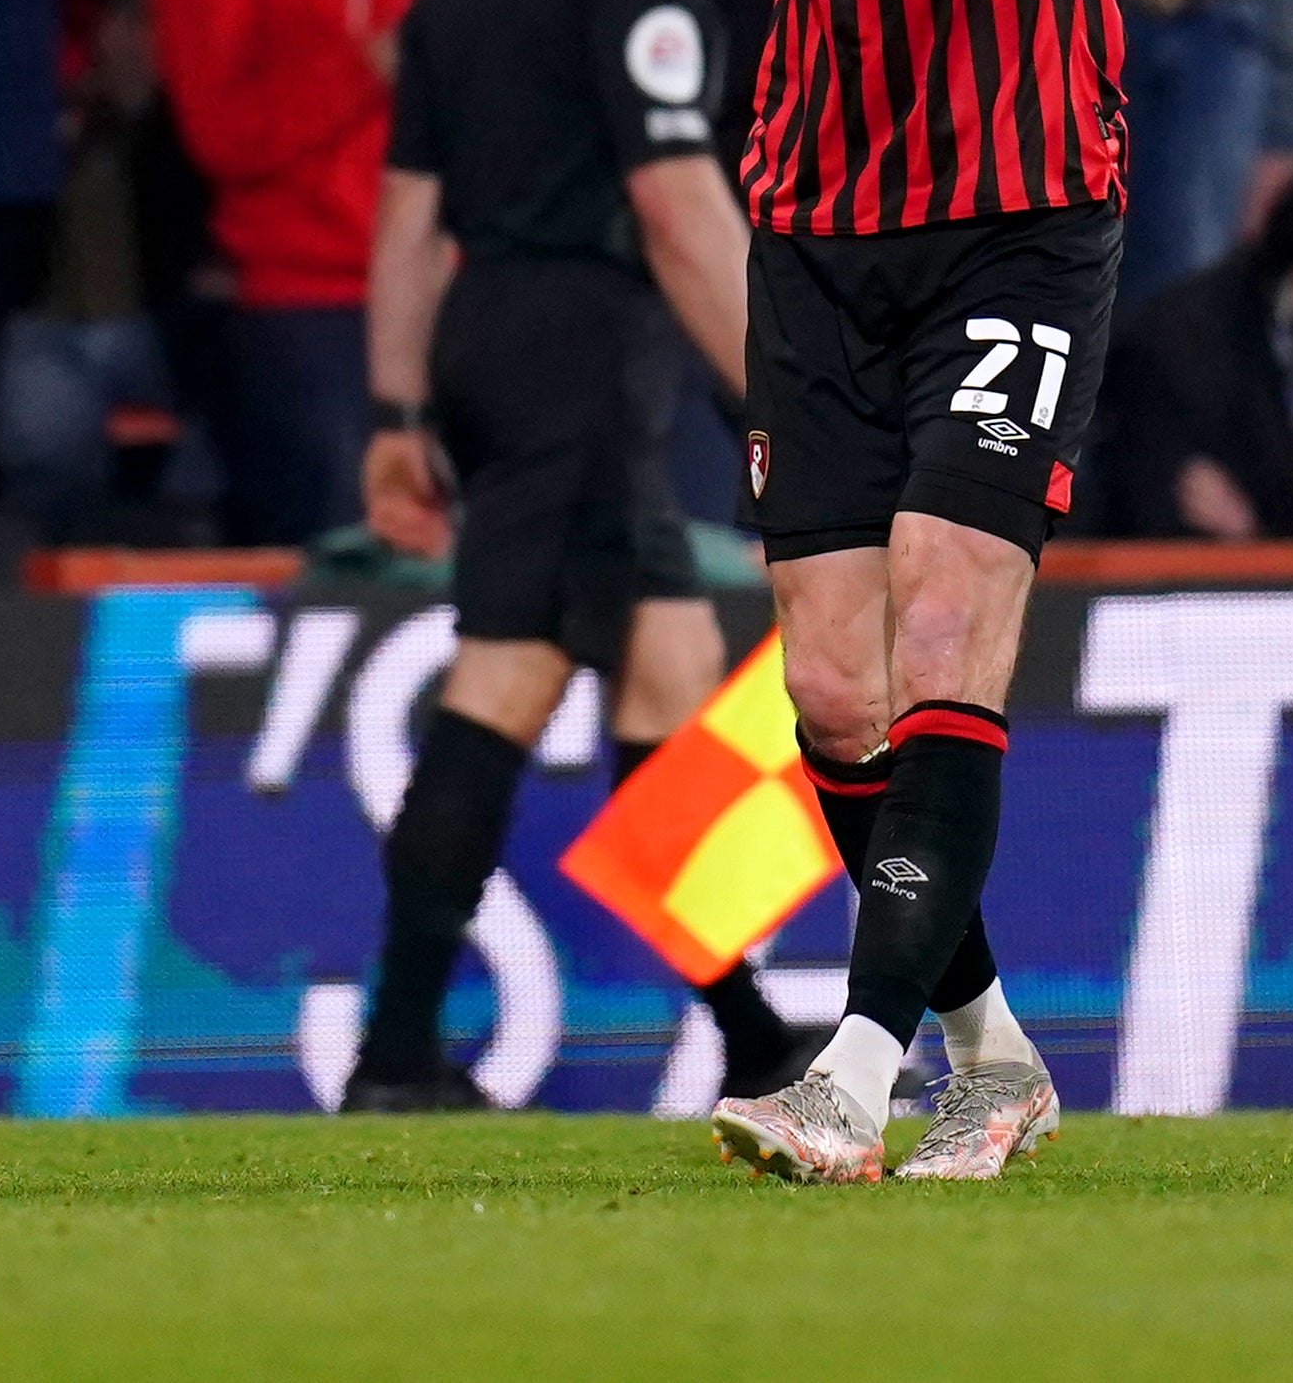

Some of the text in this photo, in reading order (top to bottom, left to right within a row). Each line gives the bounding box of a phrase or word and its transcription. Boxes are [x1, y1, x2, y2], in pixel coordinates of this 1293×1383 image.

[950, 317, 1071, 431] 21
[978, 438, 1018, 457] umbro
[871, 879, 917, 900] umbro
